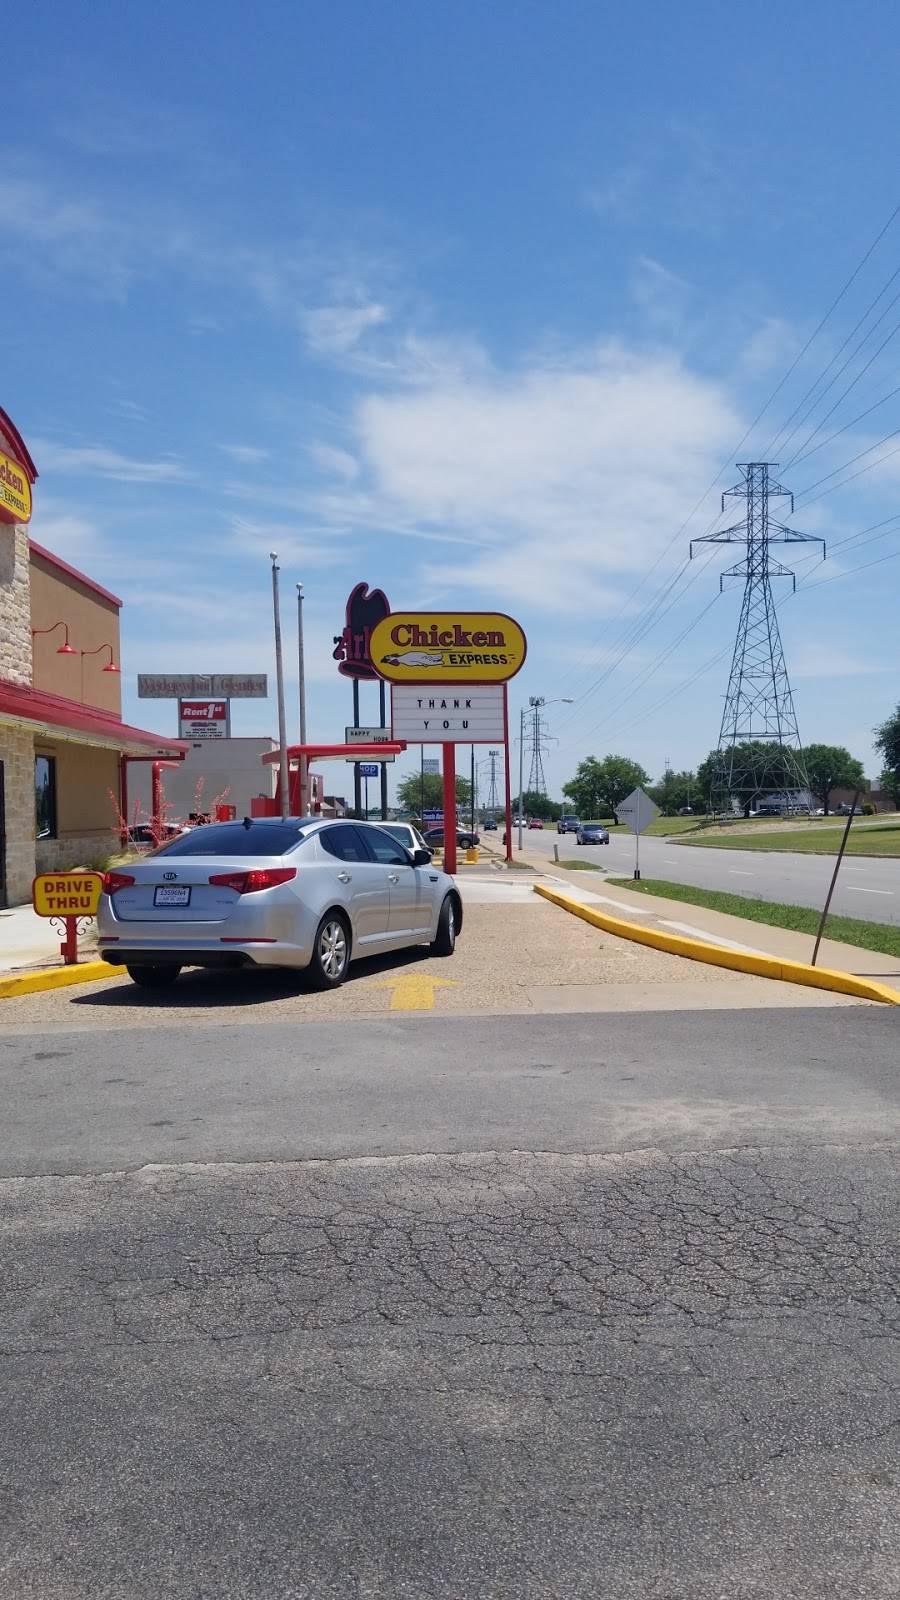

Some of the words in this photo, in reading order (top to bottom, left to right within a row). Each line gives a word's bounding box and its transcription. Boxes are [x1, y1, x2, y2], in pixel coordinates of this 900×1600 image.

[4, 490, 26, 512] EXPRESS
[391, 624, 506, 647] Chicken
[450, 654, 508, 665] EXPRESS
[417, 699, 472, 709] THANK
[183, 707, 208, 716] Rent
[424, 720, 469, 729] YOU
[44, 881, 94, 893] DRIVE
[46, 896, 91, 909] THRU
